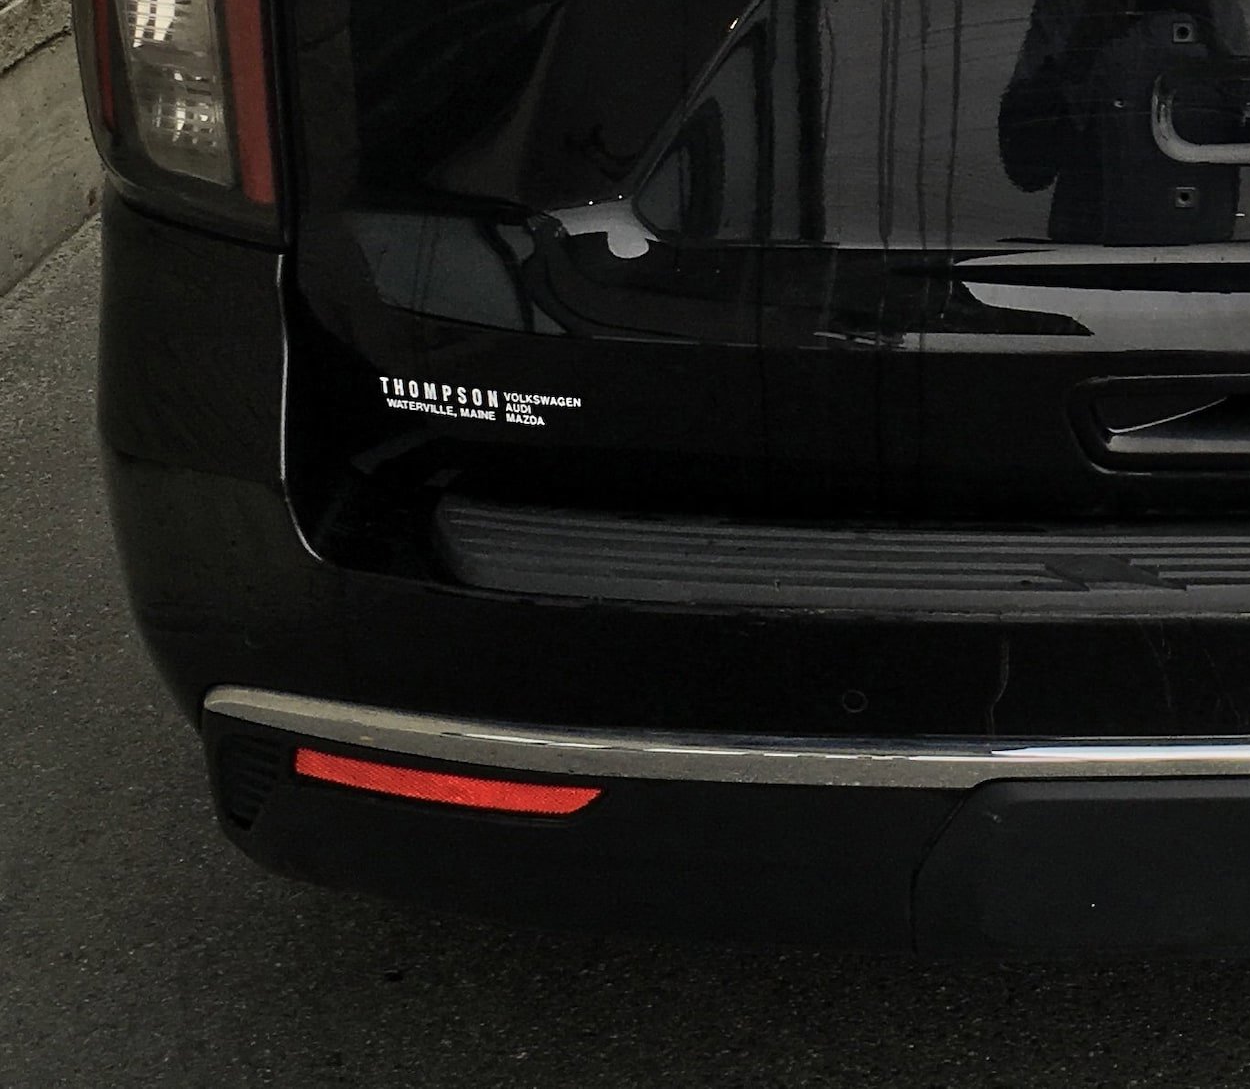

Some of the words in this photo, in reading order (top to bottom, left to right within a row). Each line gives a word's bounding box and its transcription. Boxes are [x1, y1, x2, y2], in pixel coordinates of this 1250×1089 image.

[379, 376, 499, 409] THOMPSON
[503, 391, 582, 408] VOLKSWAGEN
[386, 397, 458, 418] WATERVILLE,
[459, 407, 497, 421] MAINE
[505, 402, 532, 415] AUDI
[505, 412, 546, 426] MAZDA
